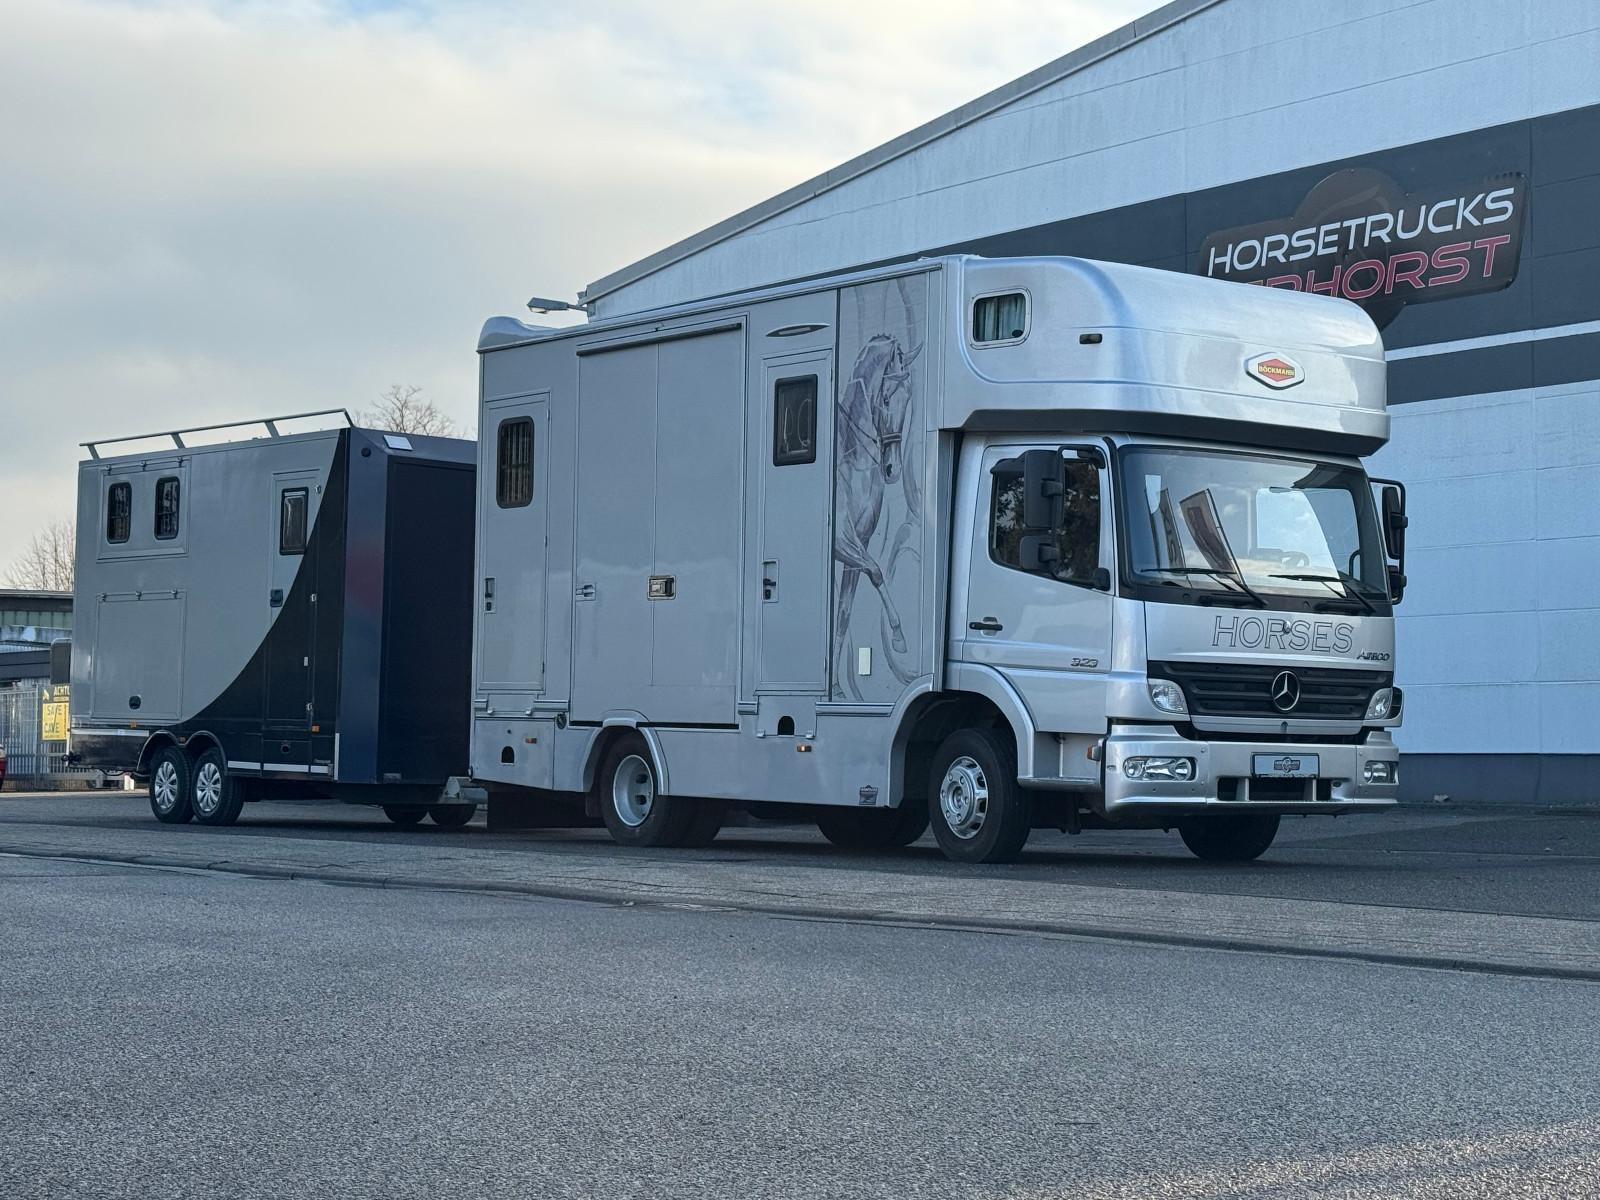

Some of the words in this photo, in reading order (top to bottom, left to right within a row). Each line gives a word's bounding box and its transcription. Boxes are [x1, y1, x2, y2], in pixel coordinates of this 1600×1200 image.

[1207, 187, 1514, 277] HORSETRUCKS
[1247, 234, 1511, 299] HORST
[1212, 615, 1354, 653] HORSES
